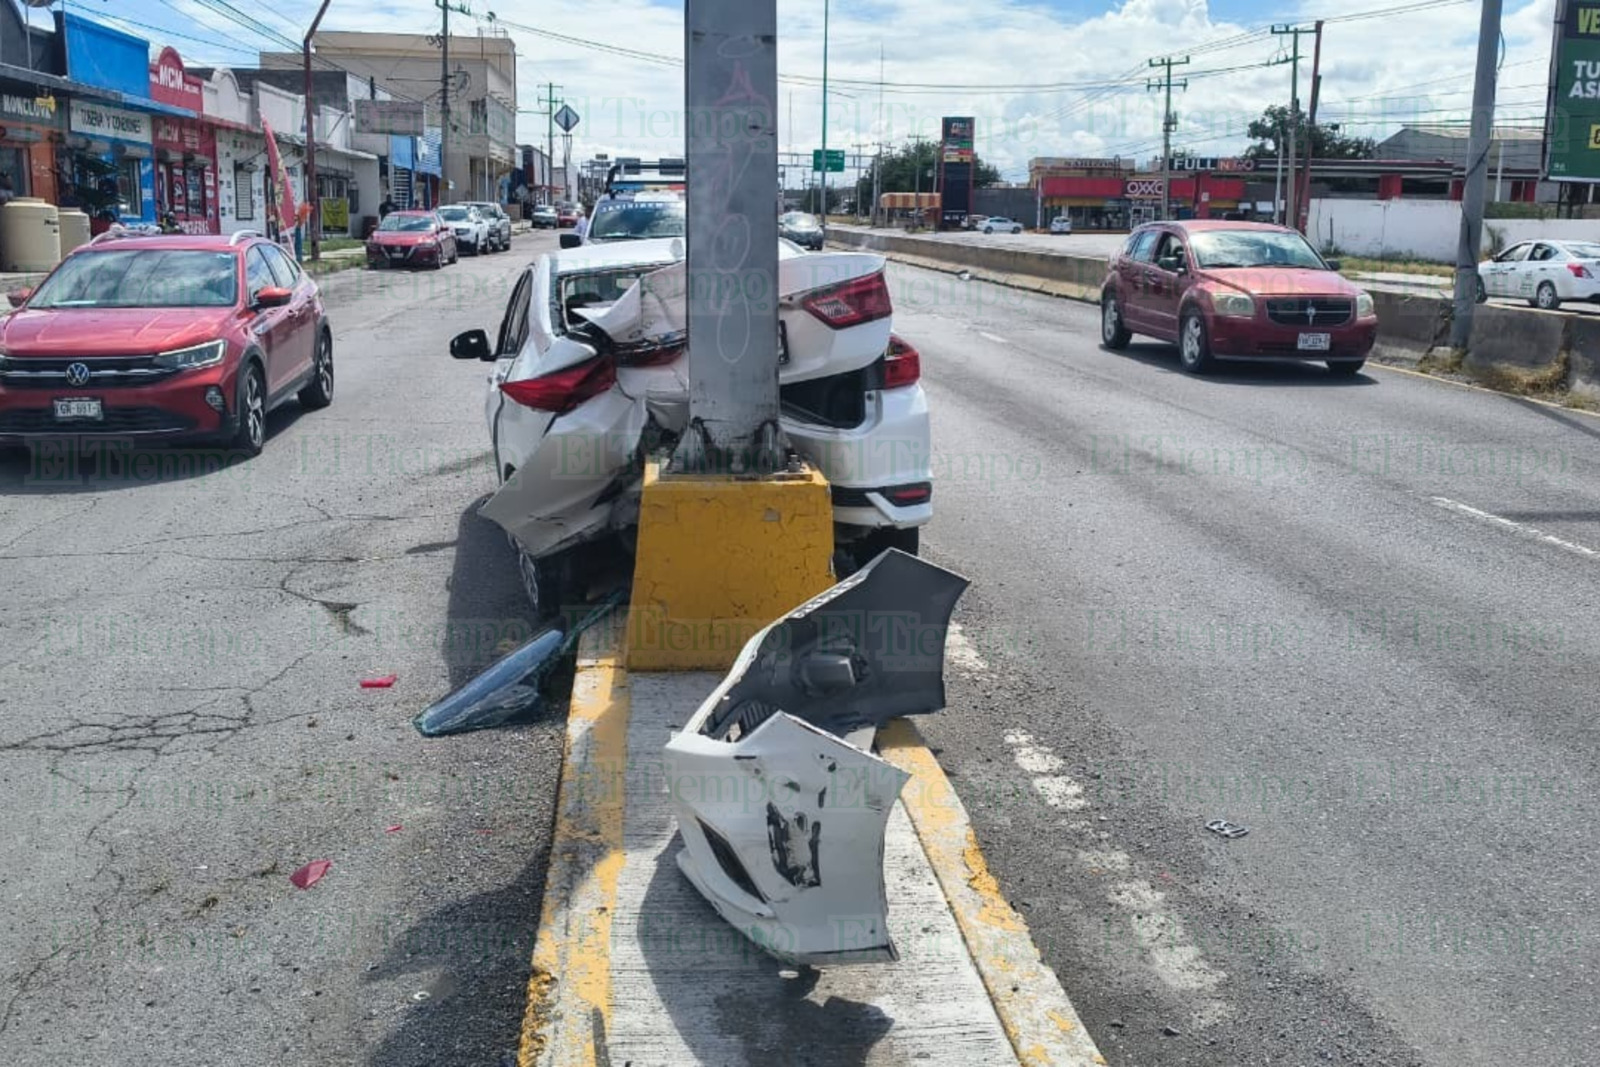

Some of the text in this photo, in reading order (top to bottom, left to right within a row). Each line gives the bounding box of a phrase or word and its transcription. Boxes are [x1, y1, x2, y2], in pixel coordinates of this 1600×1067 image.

[159, 65, 184, 92] MCM
[1174, 158, 1216, 170] FULL
[1220, 160, 1229, 171] N
[1127, 179, 1163, 195] OXXO
